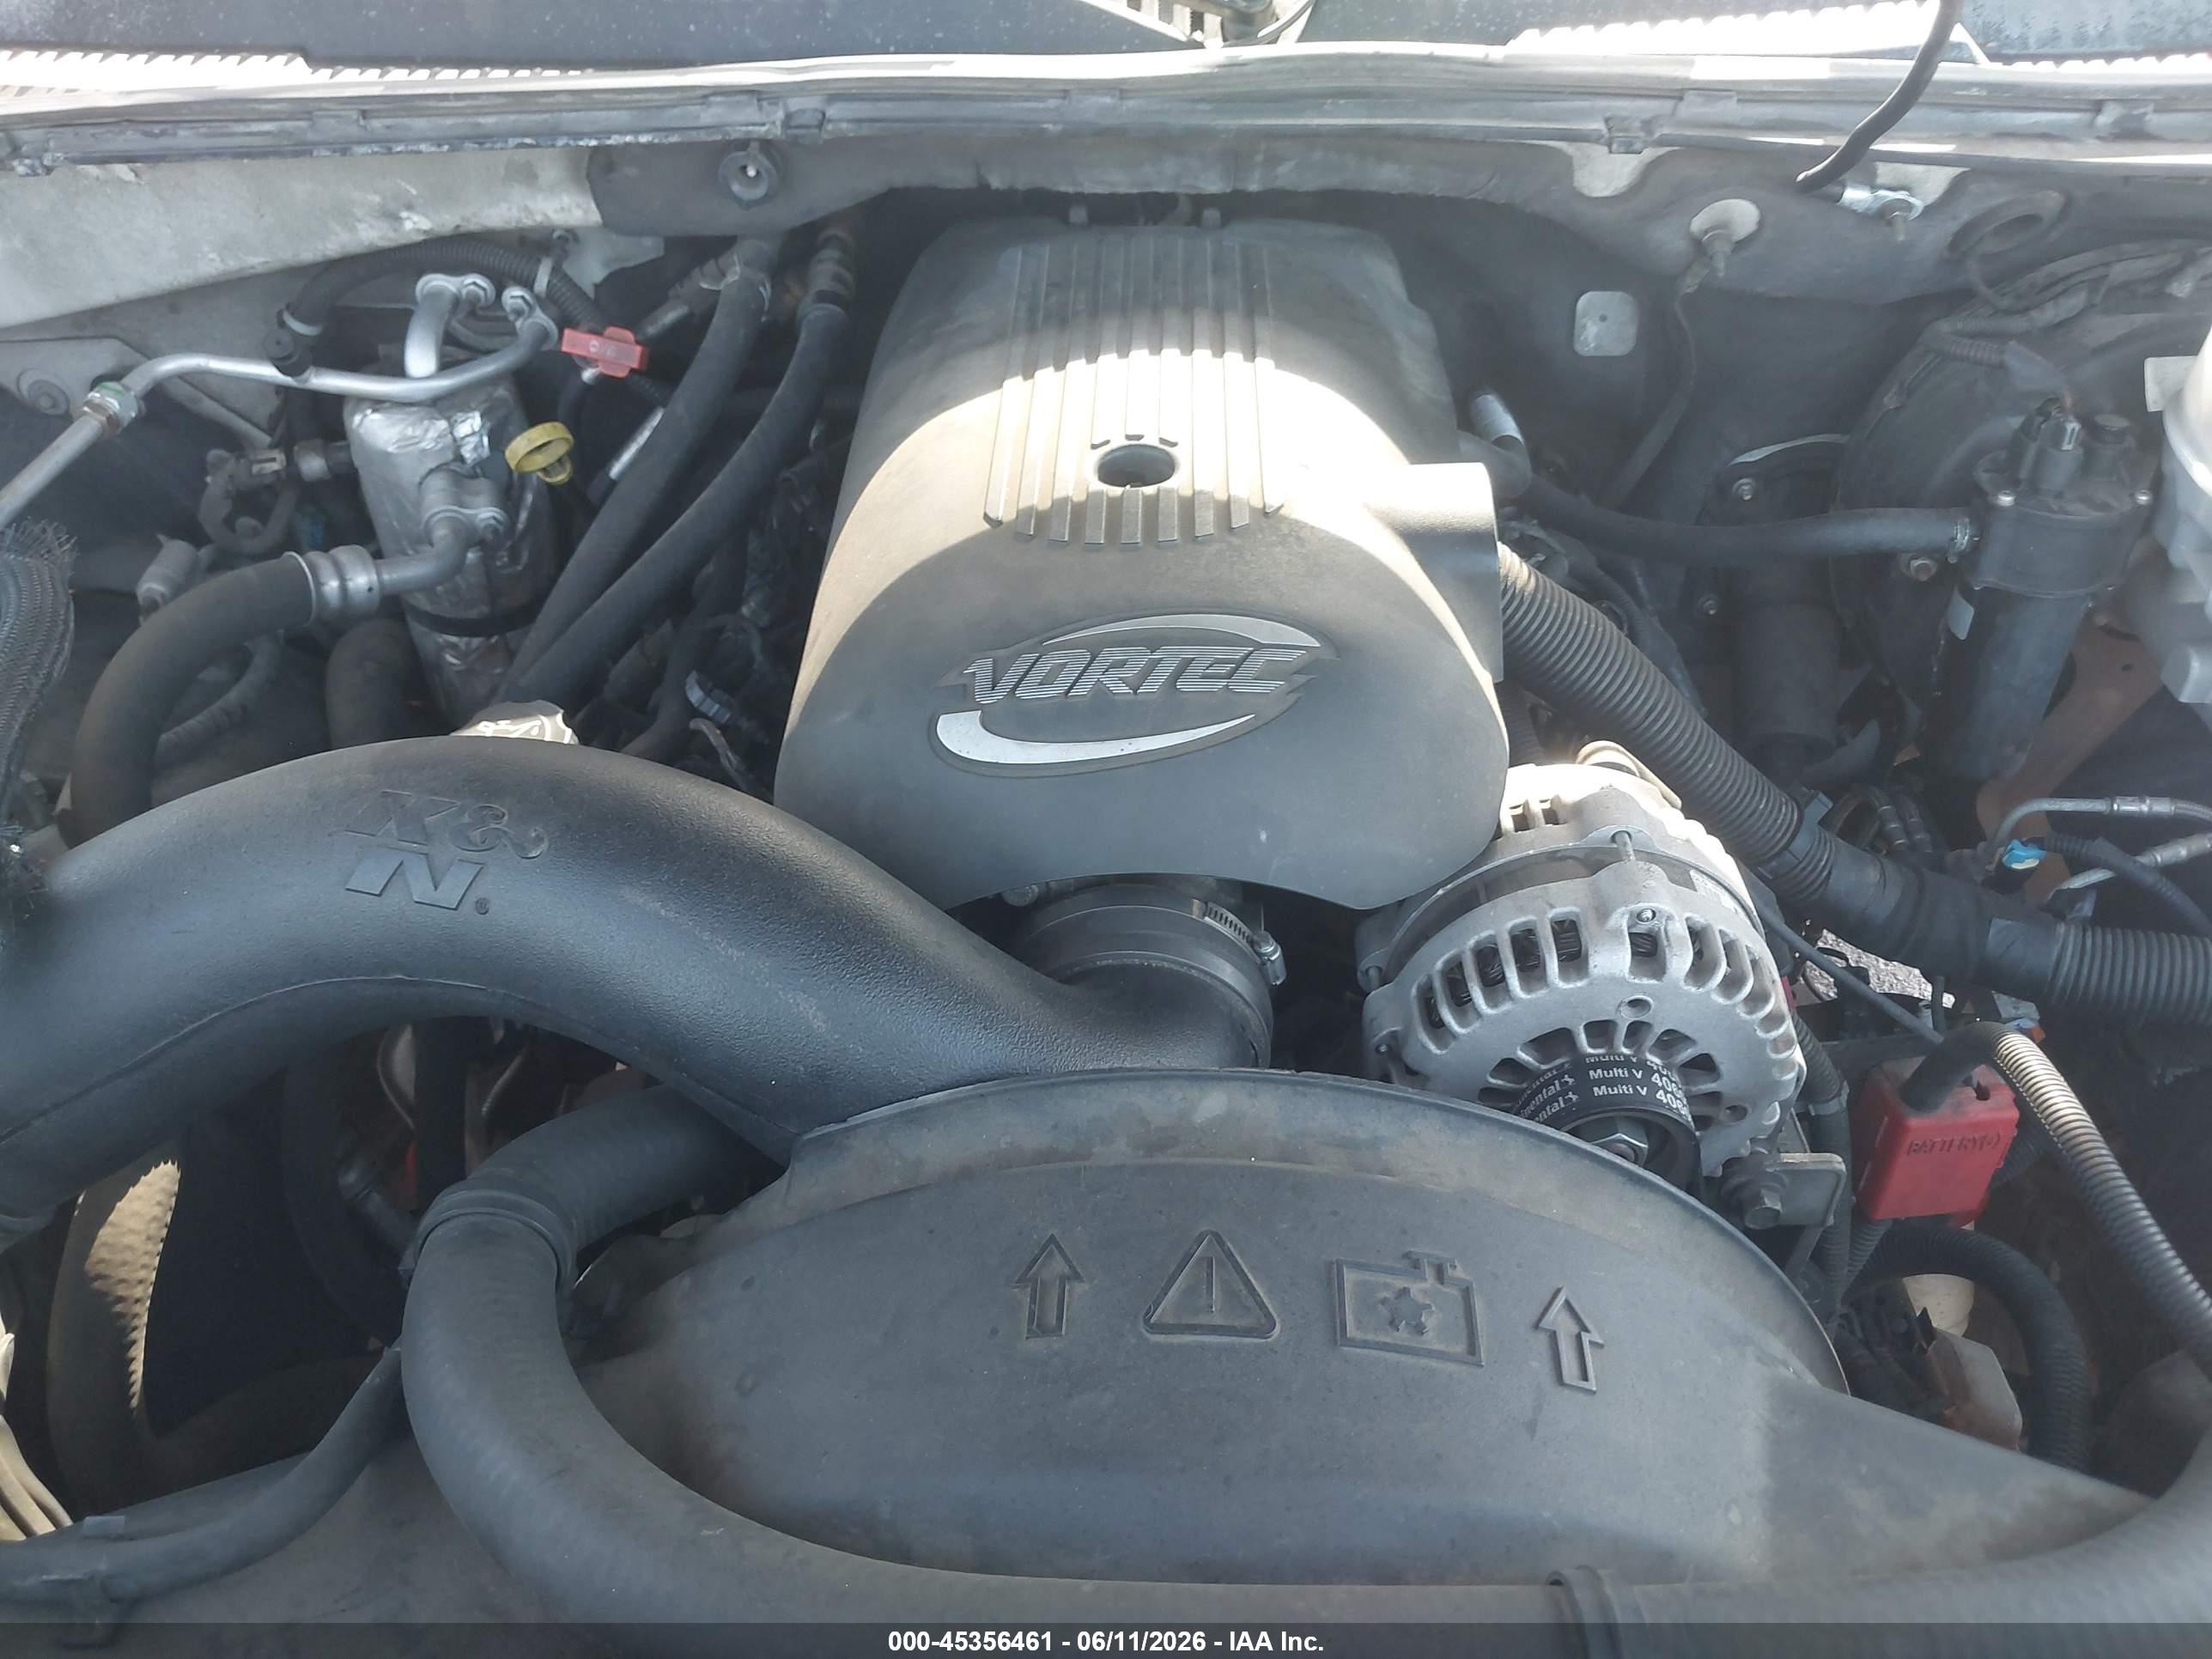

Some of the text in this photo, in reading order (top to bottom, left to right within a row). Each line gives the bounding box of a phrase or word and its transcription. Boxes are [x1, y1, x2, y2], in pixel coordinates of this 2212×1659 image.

[963, 646, 1307, 703] VORTEC
[1589, 1067, 1629, 1079] Multi
[1632, 1068, 1643, 1079] V
[1593, 1084, 1633, 1097] Multi
[1636, 1085, 1647, 1096] V
